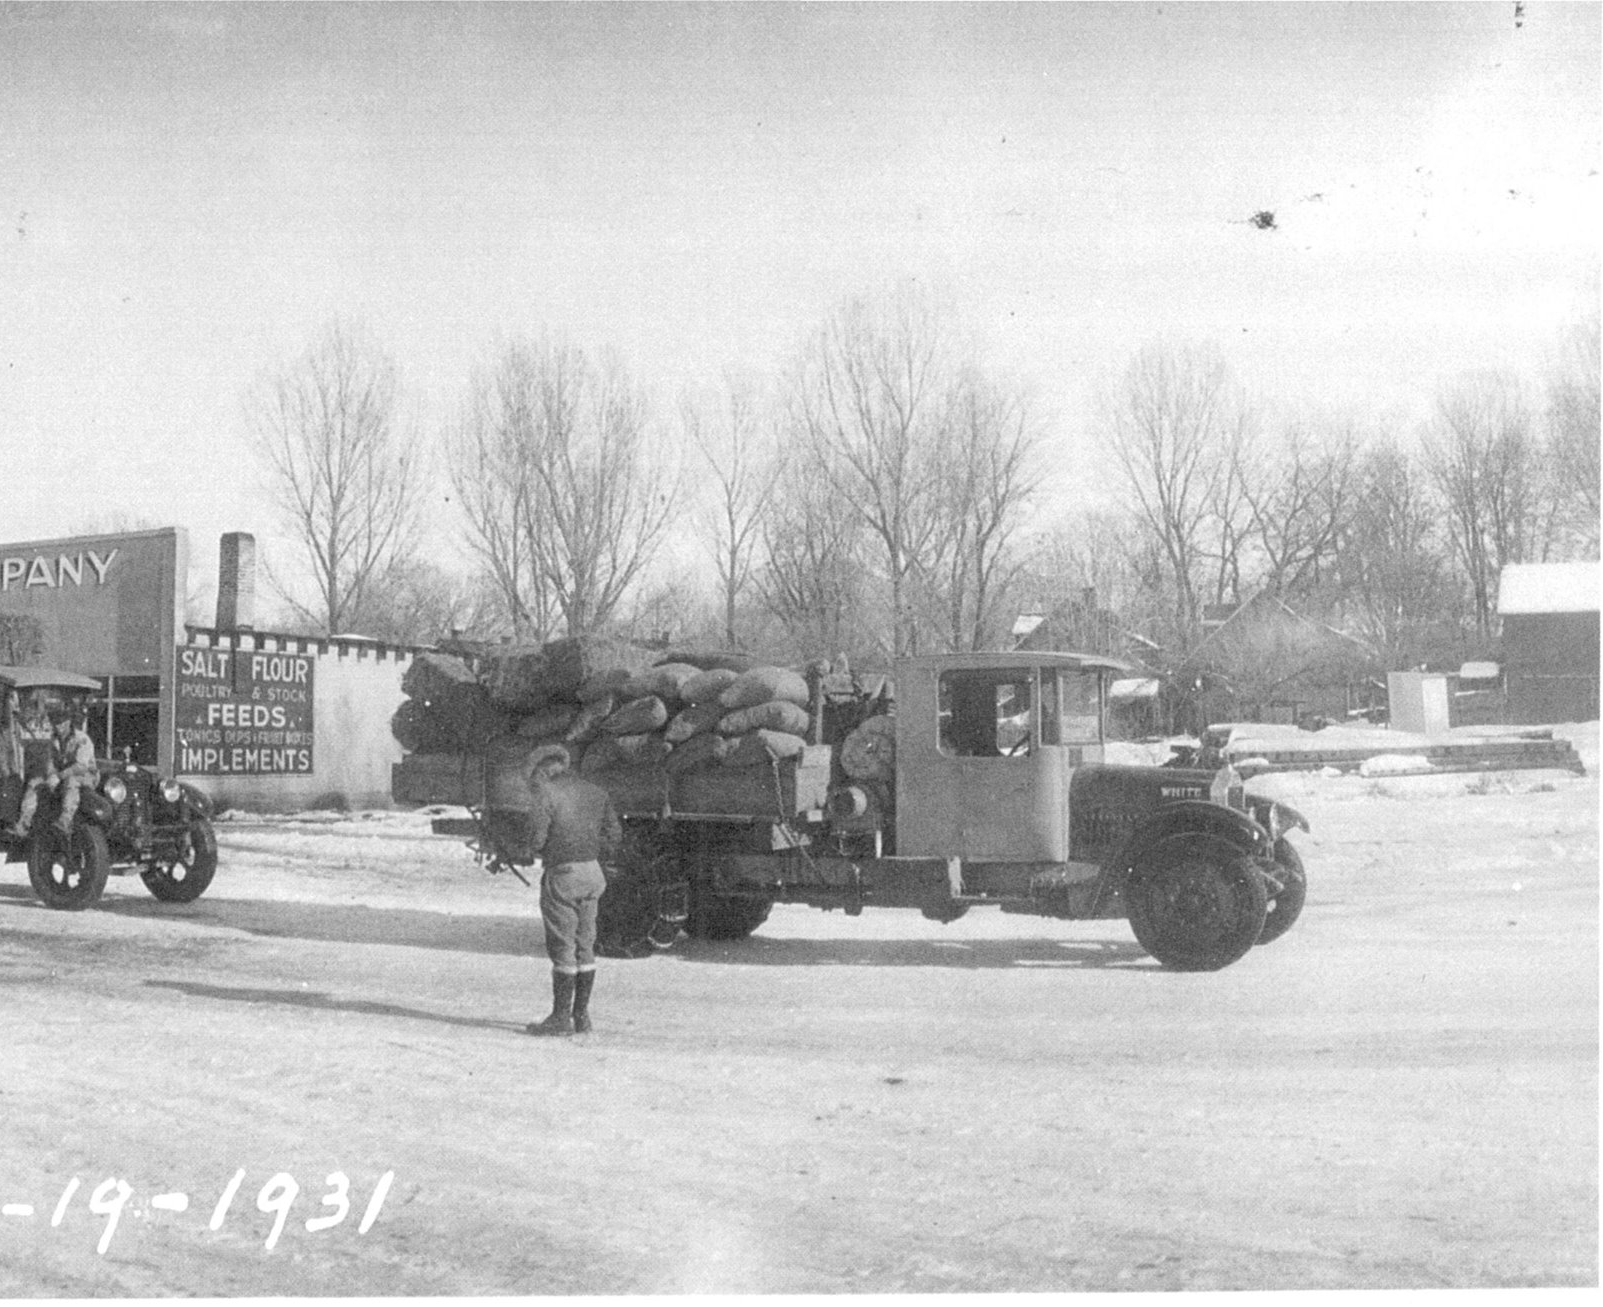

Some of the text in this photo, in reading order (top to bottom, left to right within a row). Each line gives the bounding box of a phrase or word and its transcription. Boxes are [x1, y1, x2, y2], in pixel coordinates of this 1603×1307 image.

[181, 651, 308, 683] SALT FLOUR
[181, 683, 306, 702] POULTRY & STOCK
[207, 703, 286, 728] FEEDS
[176, 728, 222, 744] TONICS
[181, 748, 310, 772] IMPLEMENTS
[1160, 786, 1203, 798] WHITE
